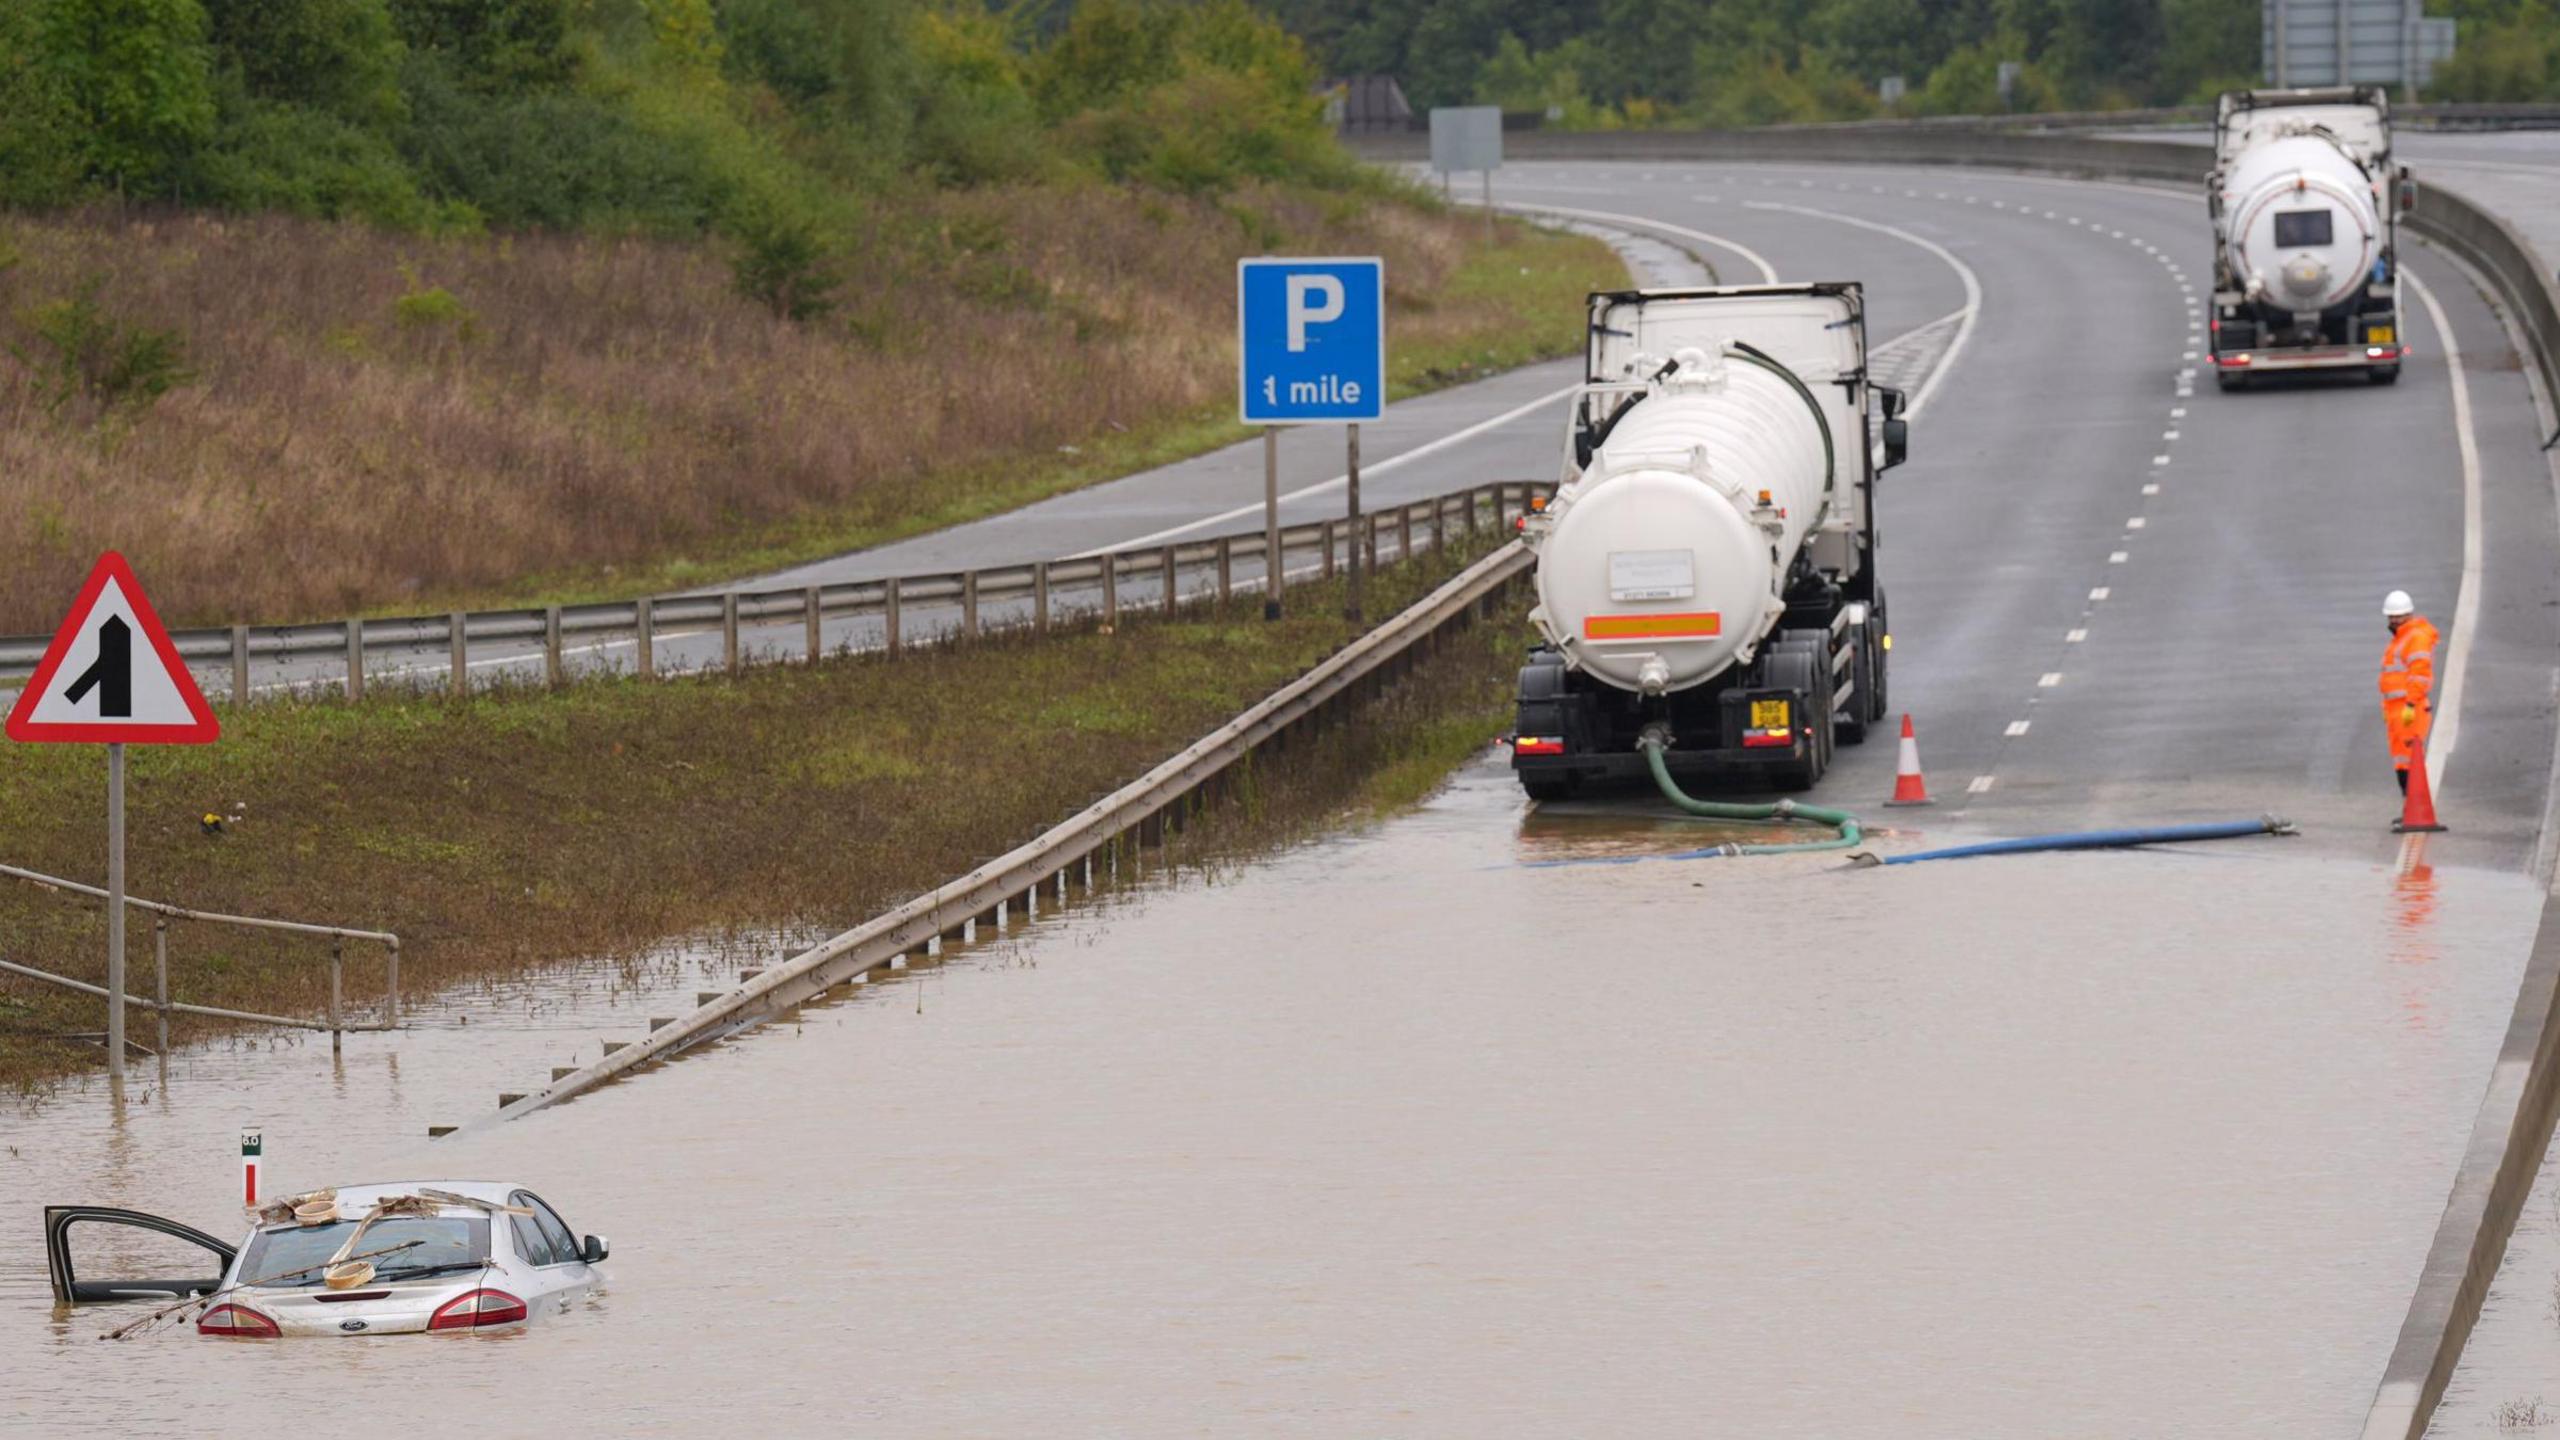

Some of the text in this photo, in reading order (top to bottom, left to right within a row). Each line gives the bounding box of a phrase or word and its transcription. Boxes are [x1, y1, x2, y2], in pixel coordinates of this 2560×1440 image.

[1286, 274, 1345, 352] P
[1263, 374, 1361, 406] 1 mile
